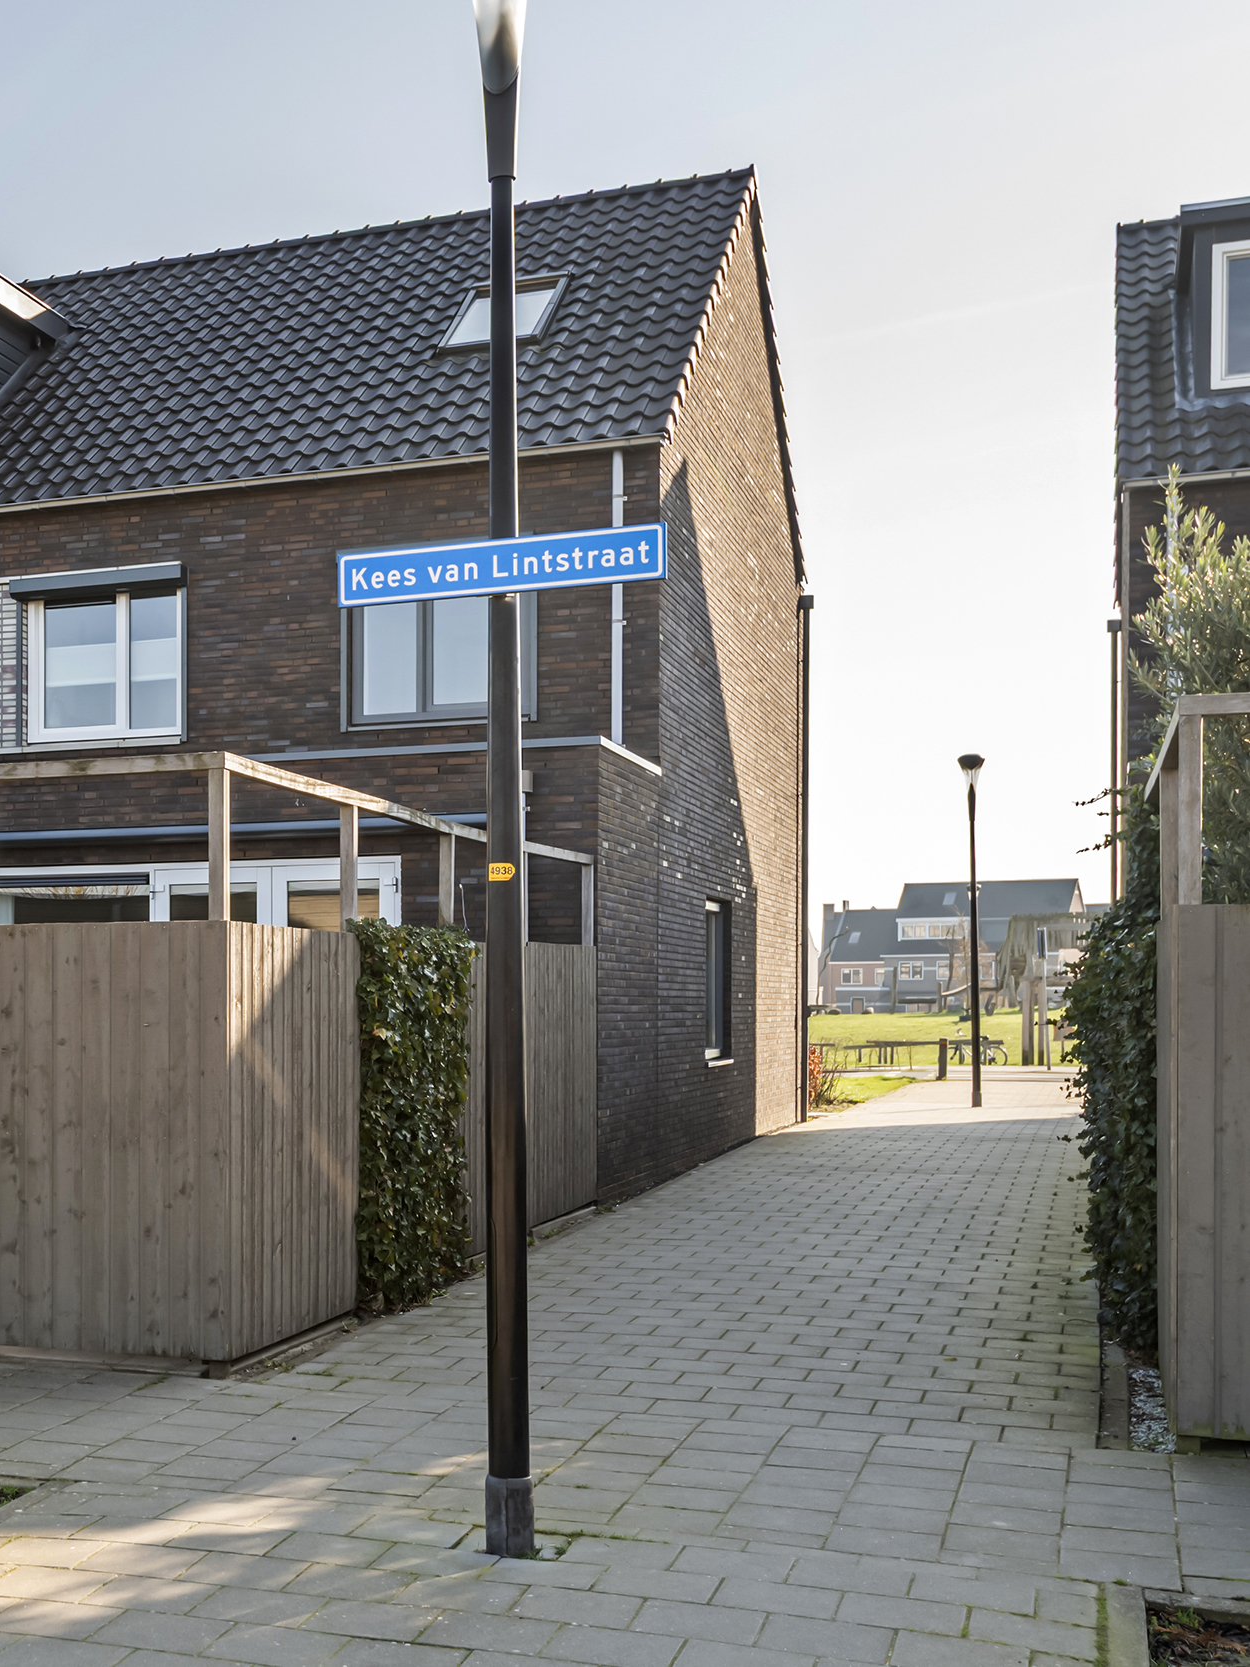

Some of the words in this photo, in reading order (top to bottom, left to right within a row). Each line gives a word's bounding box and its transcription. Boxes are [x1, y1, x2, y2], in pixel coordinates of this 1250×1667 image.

[351, 567, 417, 591] Kees
[427, 561, 479, 584] van
[492, 540, 650, 578] Lintstraat
[491, 866, 513, 875] 4938
